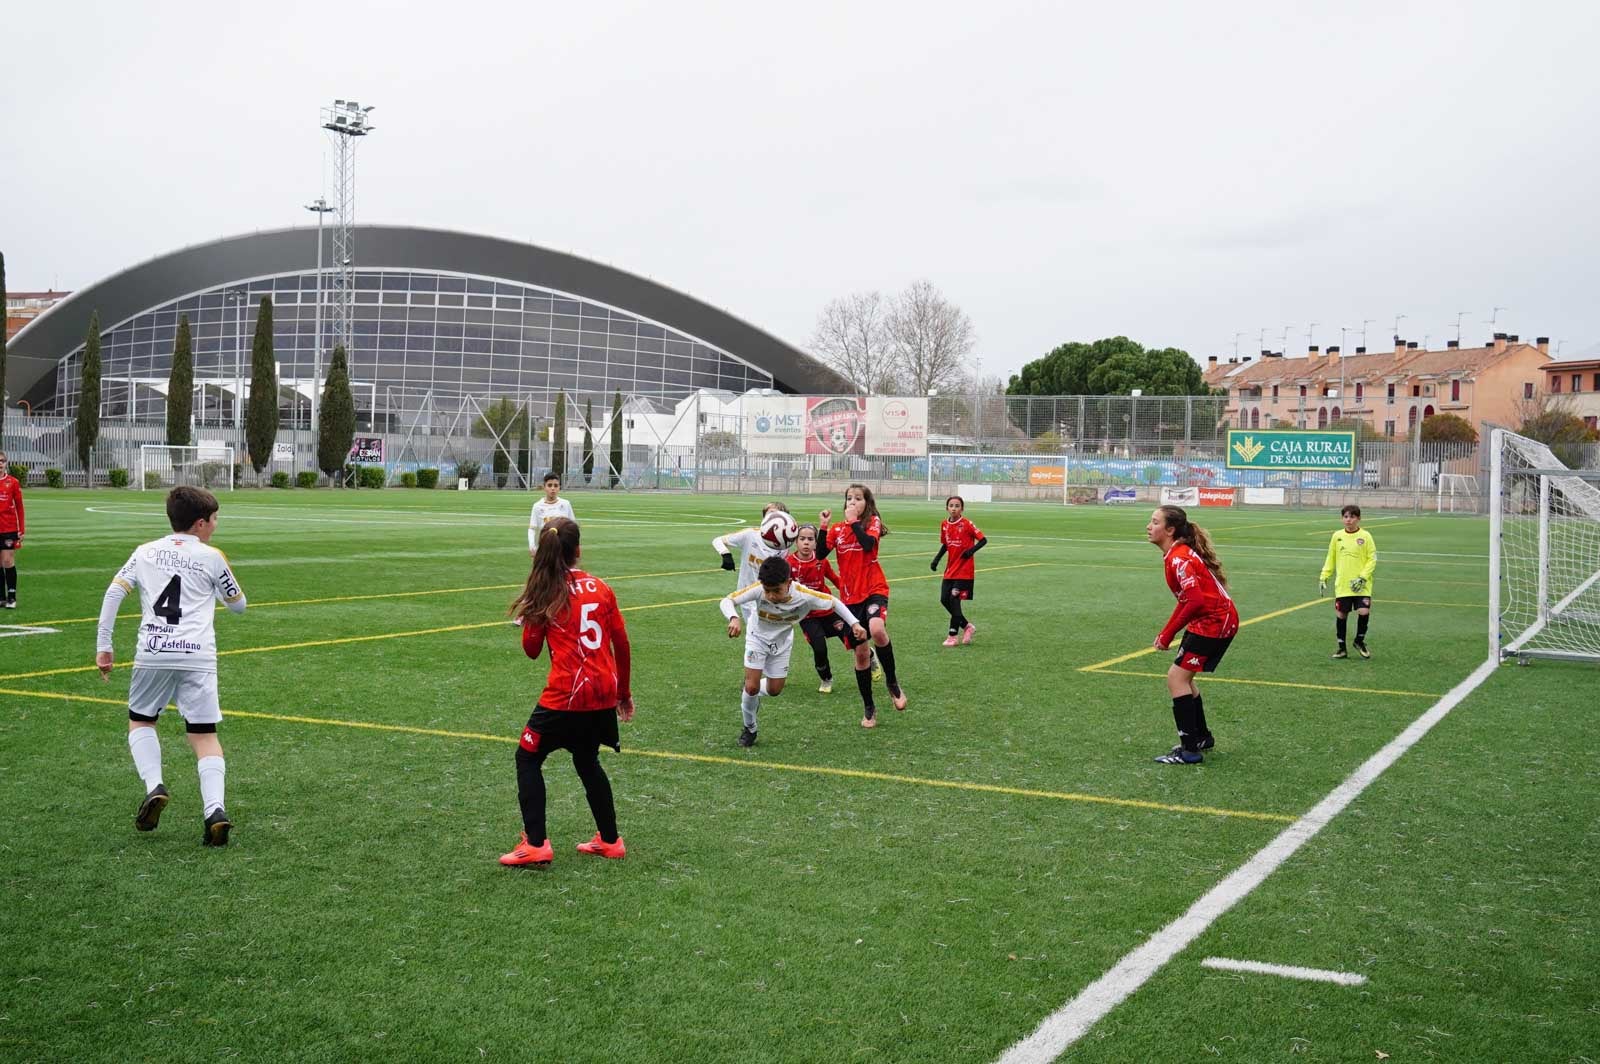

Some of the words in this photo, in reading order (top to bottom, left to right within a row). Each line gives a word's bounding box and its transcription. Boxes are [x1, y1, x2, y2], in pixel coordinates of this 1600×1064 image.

[775, 414, 802, 426] MST
[1270, 440, 1302, 454] CAJA
[1306, 441, 1350, 453] RURAL
[1270, 455, 1284, 464] DE
[1285, 455, 1350, 465] SALAMANCA
[1199, 491, 1234, 502] telepizza
[155, 555, 204, 572] muebles
[218, 570, 237, 598] THC
[152, 574, 183, 626] 4
[579, 602, 603, 650] 5
[148, 635, 201, 651] Castellano
